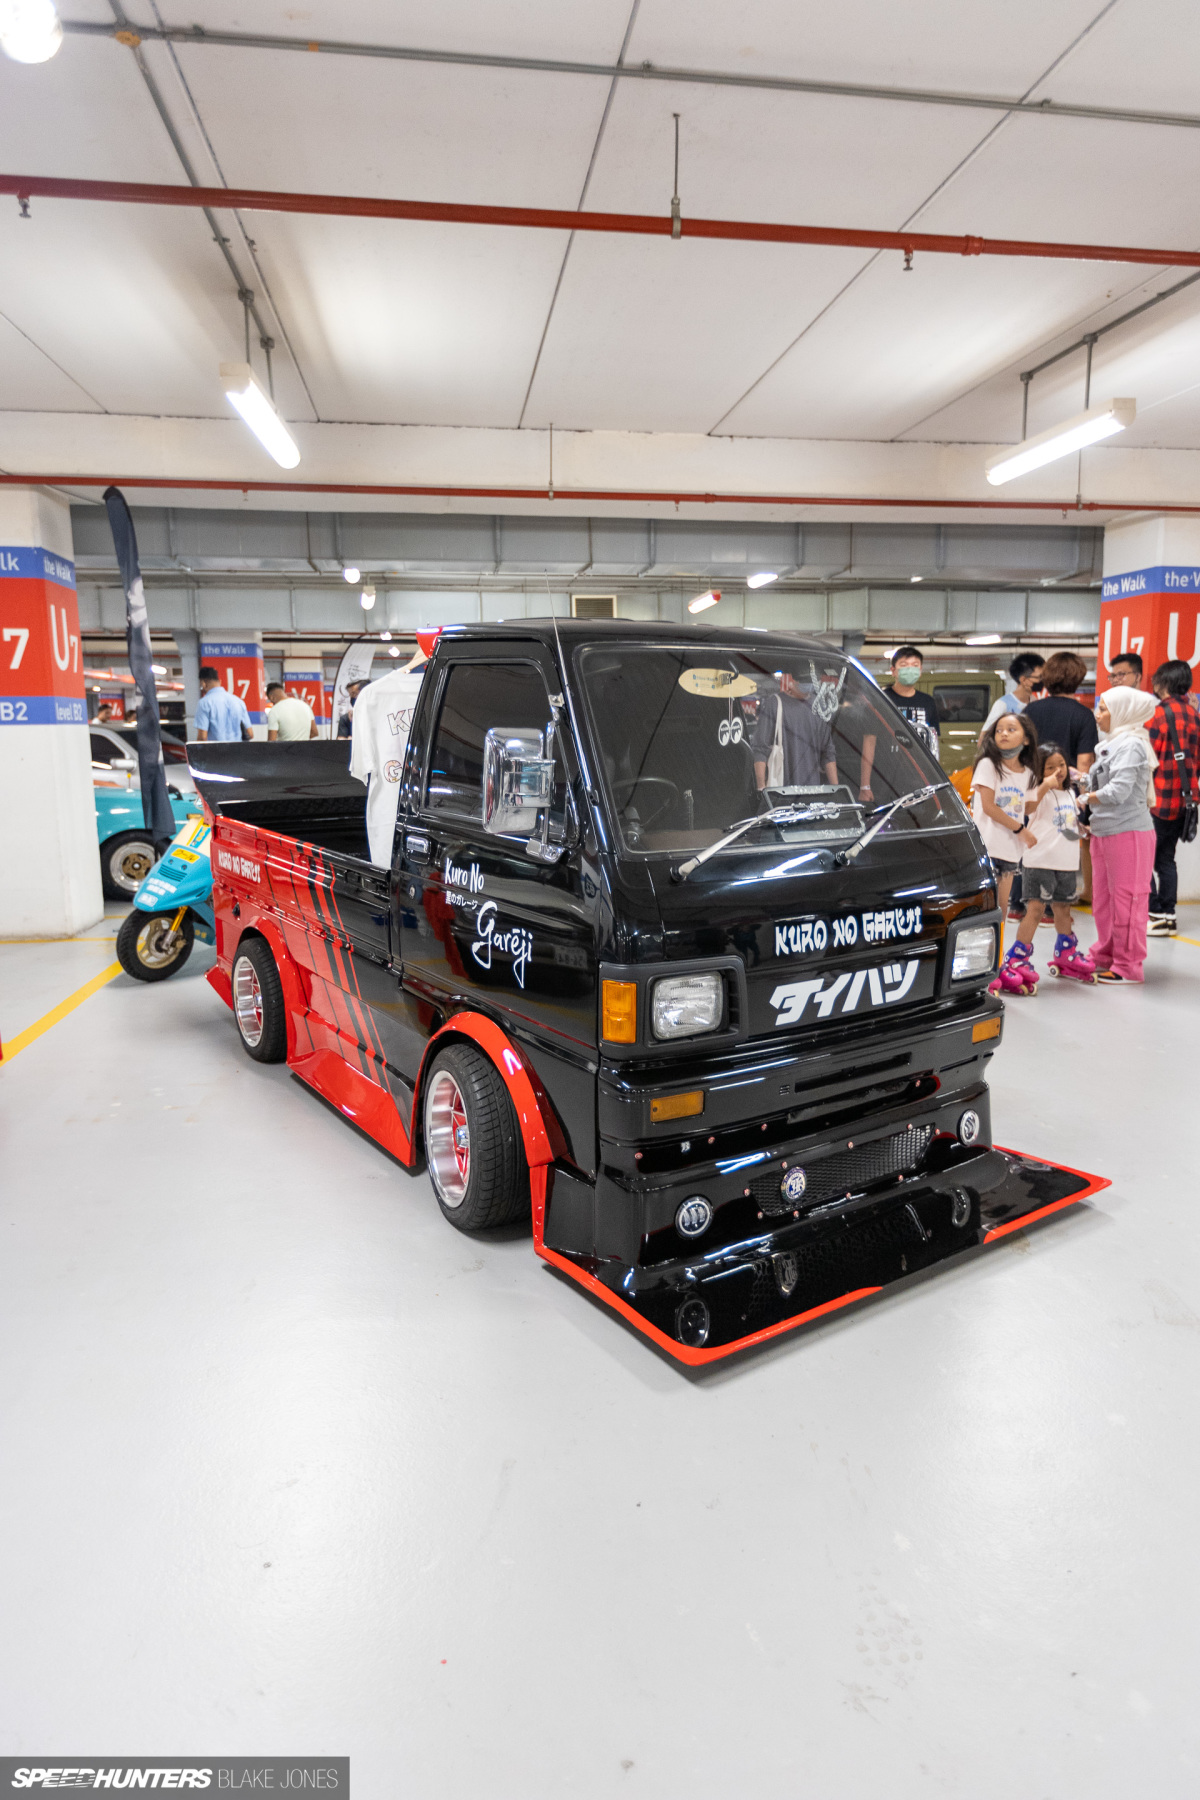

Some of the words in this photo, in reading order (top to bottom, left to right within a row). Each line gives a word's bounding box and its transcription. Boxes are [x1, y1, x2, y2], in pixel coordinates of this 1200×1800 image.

[43, 556, 56, 576] the
[56, 560, 73, 582] Walk
[1164, 571, 1188, 587] the
[1103, 581, 1119, 597] the
[1121, 574, 1146, 594] Walk
[204, 645, 221, 655] the
[222, 645, 247, 655] Walk
[0, 701, 29, 722] B2
[56, 702, 74, 721] level
[73, 702, 83, 722] B2
[444, 857, 468, 886] Kuro
[469, 863, 485, 894] No
[774, 920, 828, 957] KURO
[832, 914, 859, 948] NO
